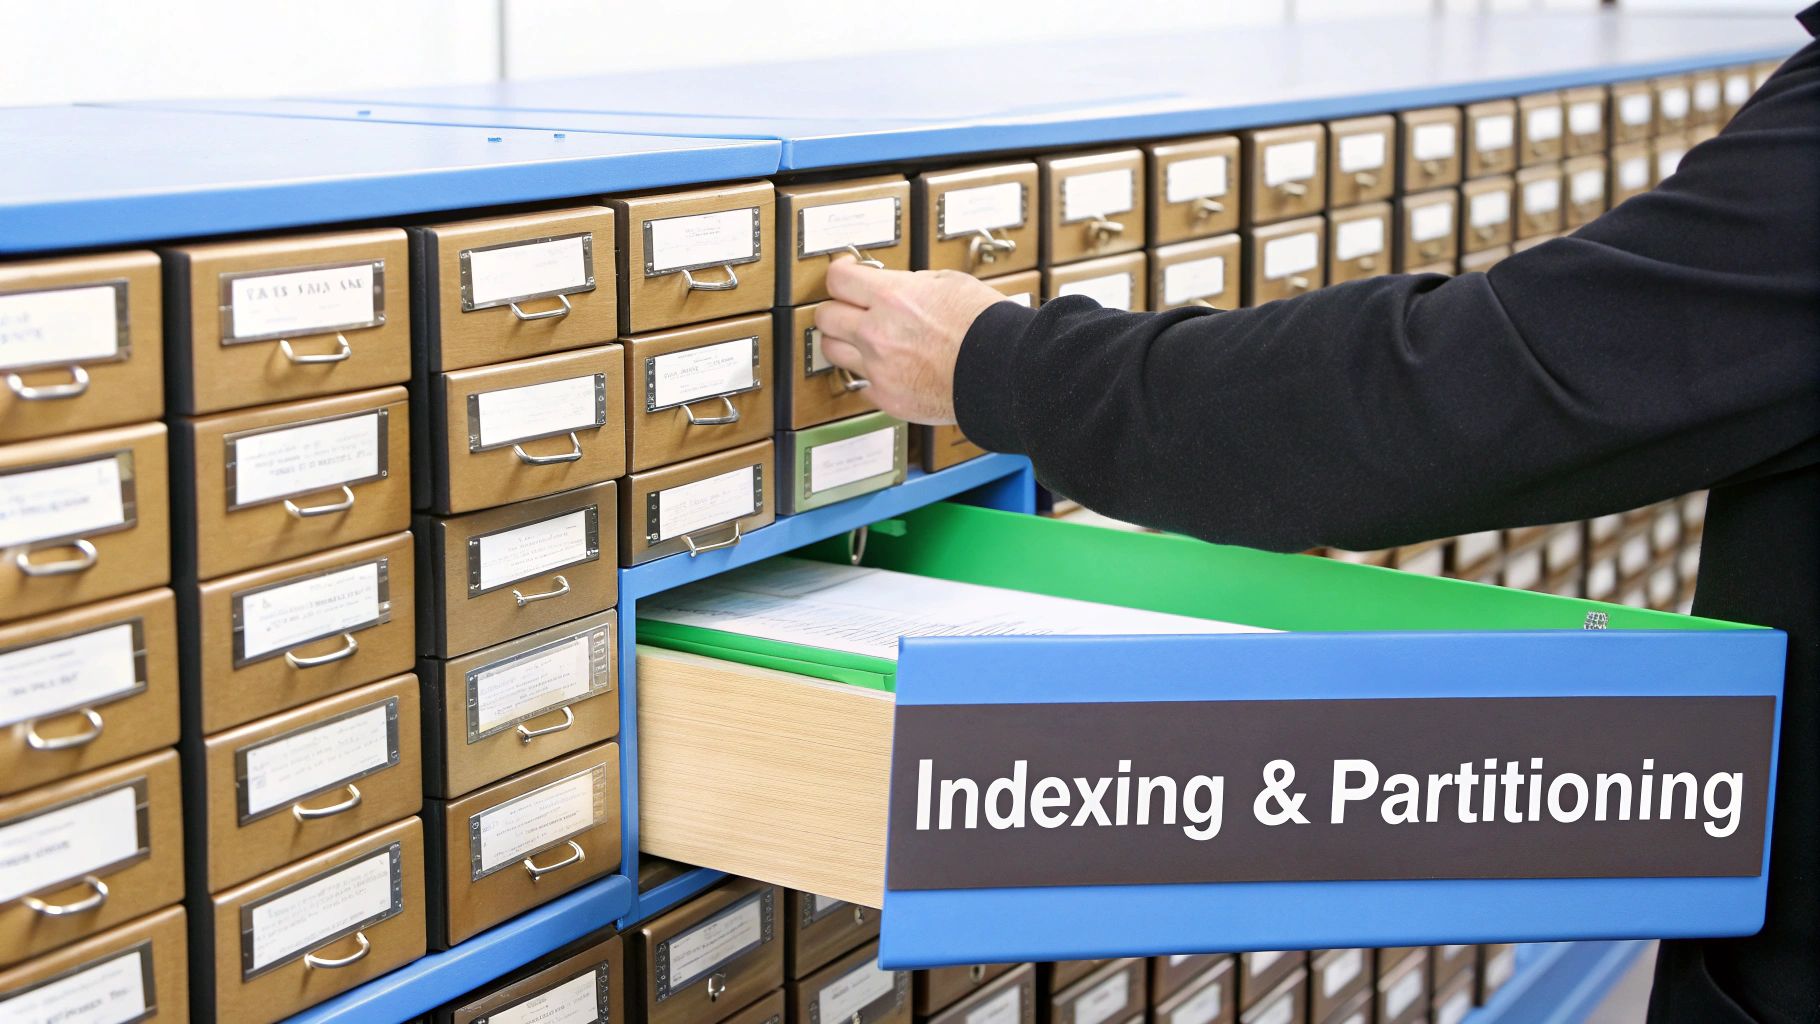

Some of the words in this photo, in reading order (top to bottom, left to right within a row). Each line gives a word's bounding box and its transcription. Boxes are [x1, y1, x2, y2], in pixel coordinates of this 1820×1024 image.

[916, 759, 1225, 841] Indexing
[1253, 759, 1311, 826] &
[1330, 757, 1743, 838] Partitioning
